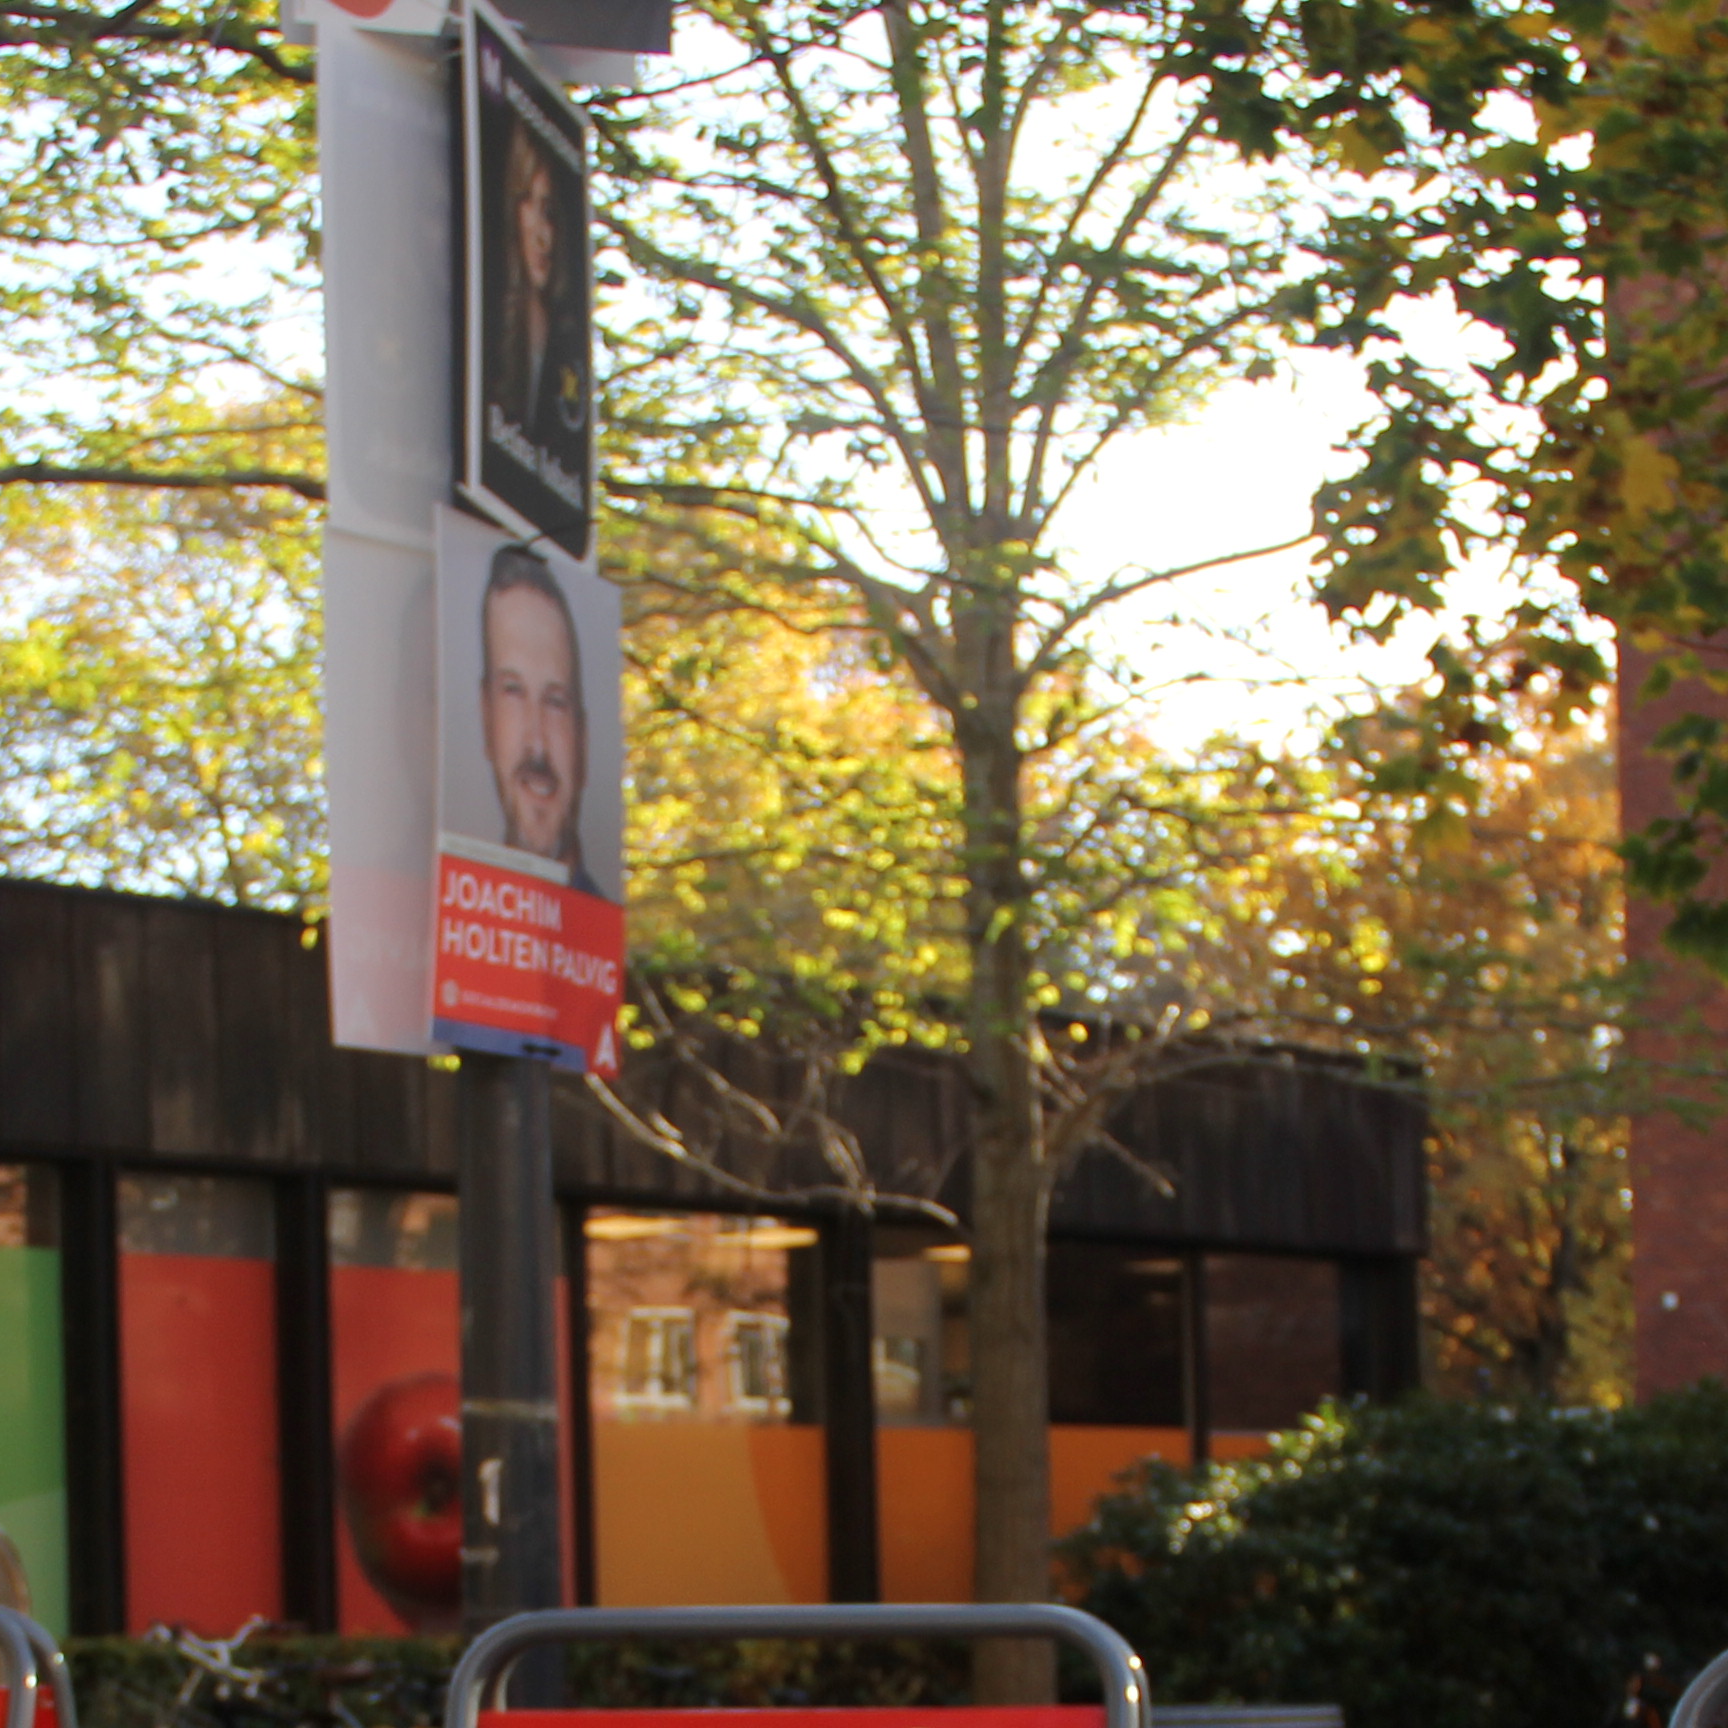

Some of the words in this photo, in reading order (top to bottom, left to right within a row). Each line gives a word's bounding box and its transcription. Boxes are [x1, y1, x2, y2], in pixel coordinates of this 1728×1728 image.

[442, 872, 563, 932] JOACHIM
[442, 917, 550, 971] HOLTEN
[552, 943, 618, 996] PALVIG
